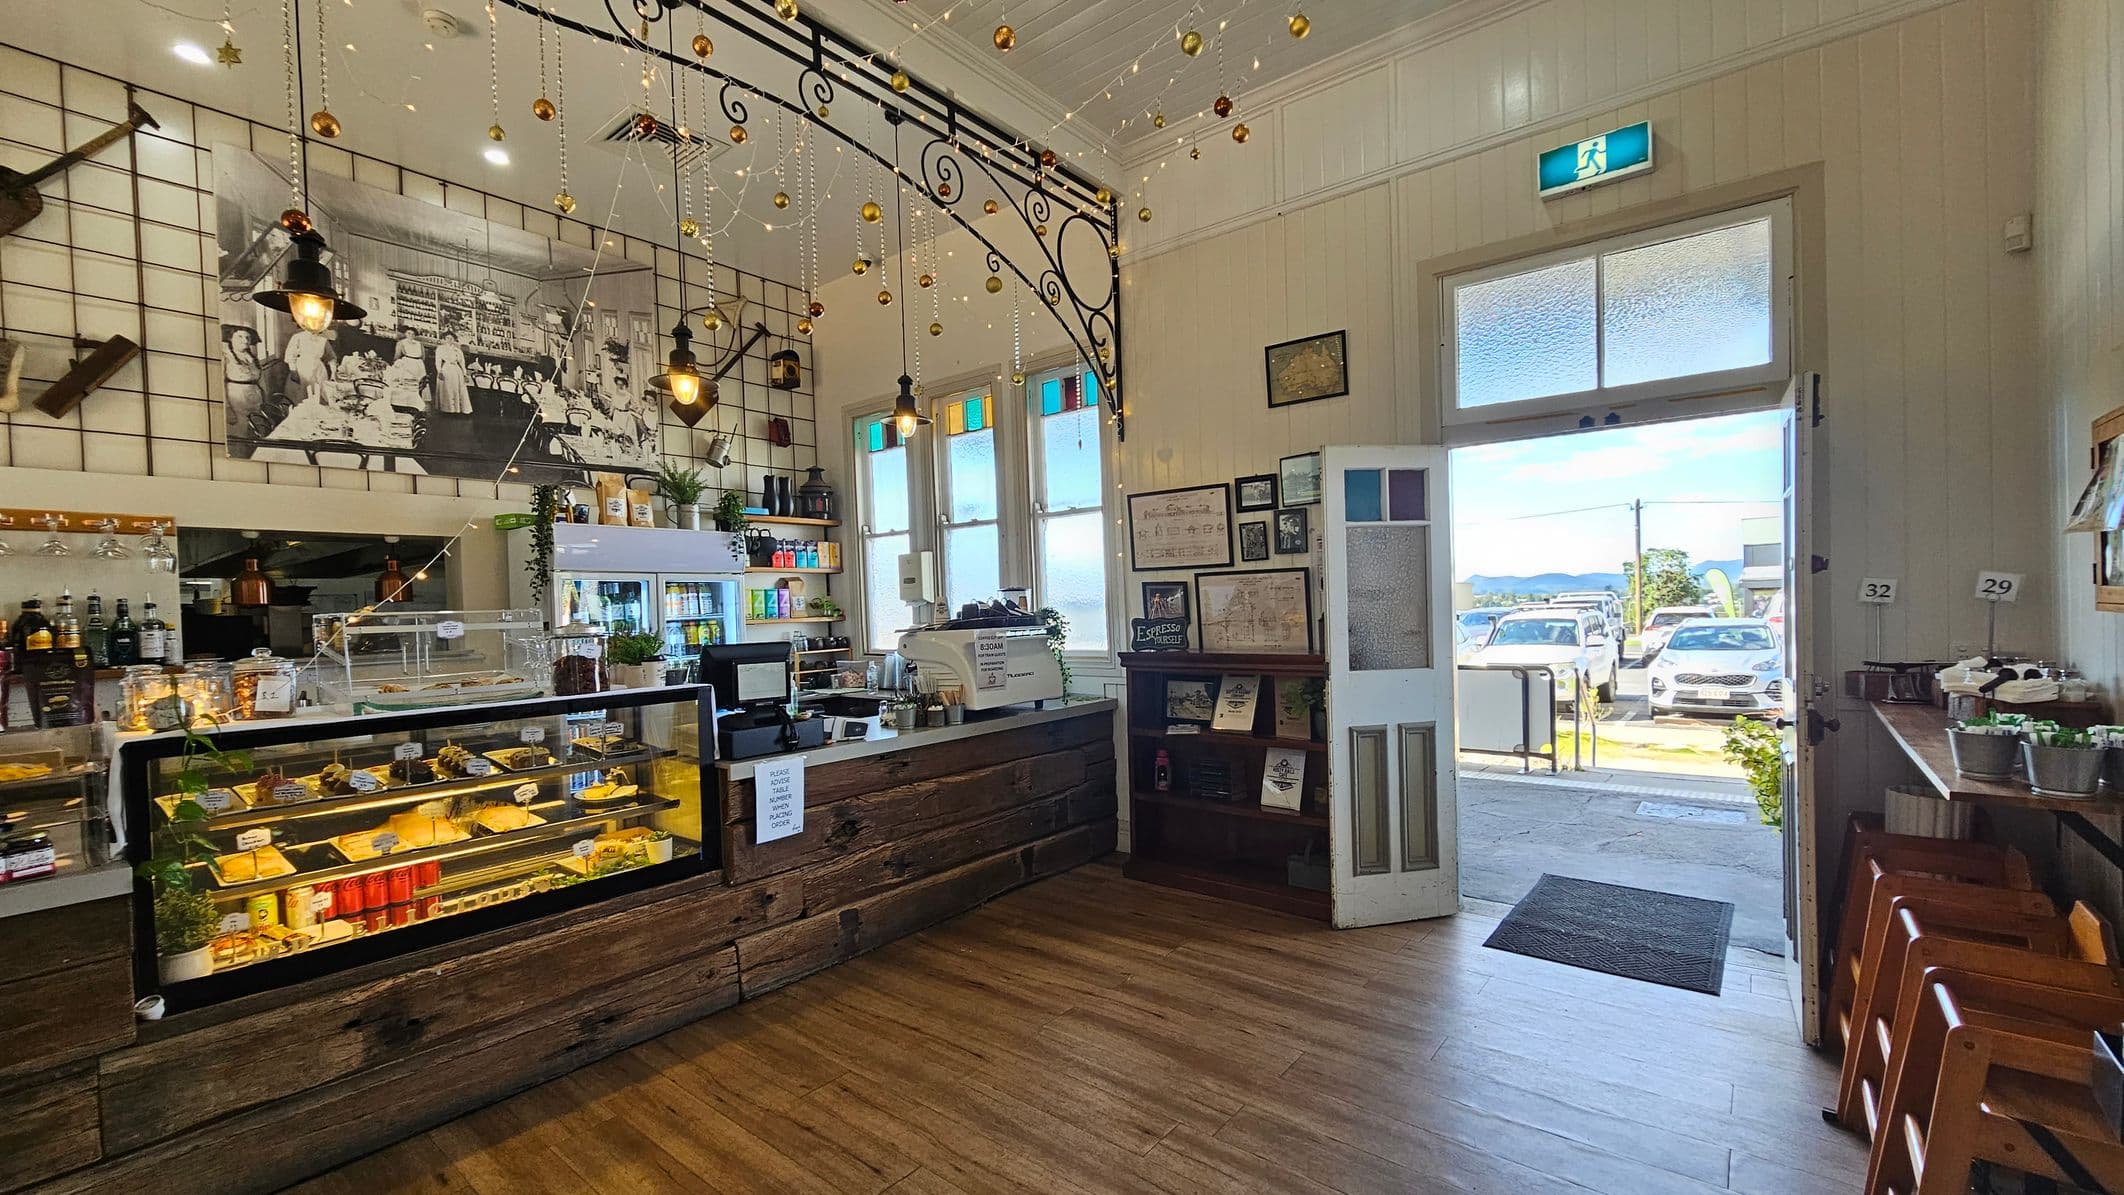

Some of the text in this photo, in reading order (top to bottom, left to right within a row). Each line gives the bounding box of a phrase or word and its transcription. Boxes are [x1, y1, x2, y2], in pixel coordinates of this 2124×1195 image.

[1865, 583, 1892, 598] 32
[1982, 578, 2013, 595] 29
[1136, 623, 1181, 642] ESPRESSO
[1152, 635, 1184, 645] YOURSELF
[980, 642, 1003, 651] 8:30AM
[769, 768, 790, 777] PLEASE
[770, 777, 790, 786] ADVISE
[773, 785, 789, 794] TABLE
[769, 794, 792, 803] NUMBER
[772, 803, 790, 811] WHEN
[769, 810, 792, 821] PLACING
[771, 819, 790, 829] ORDER
